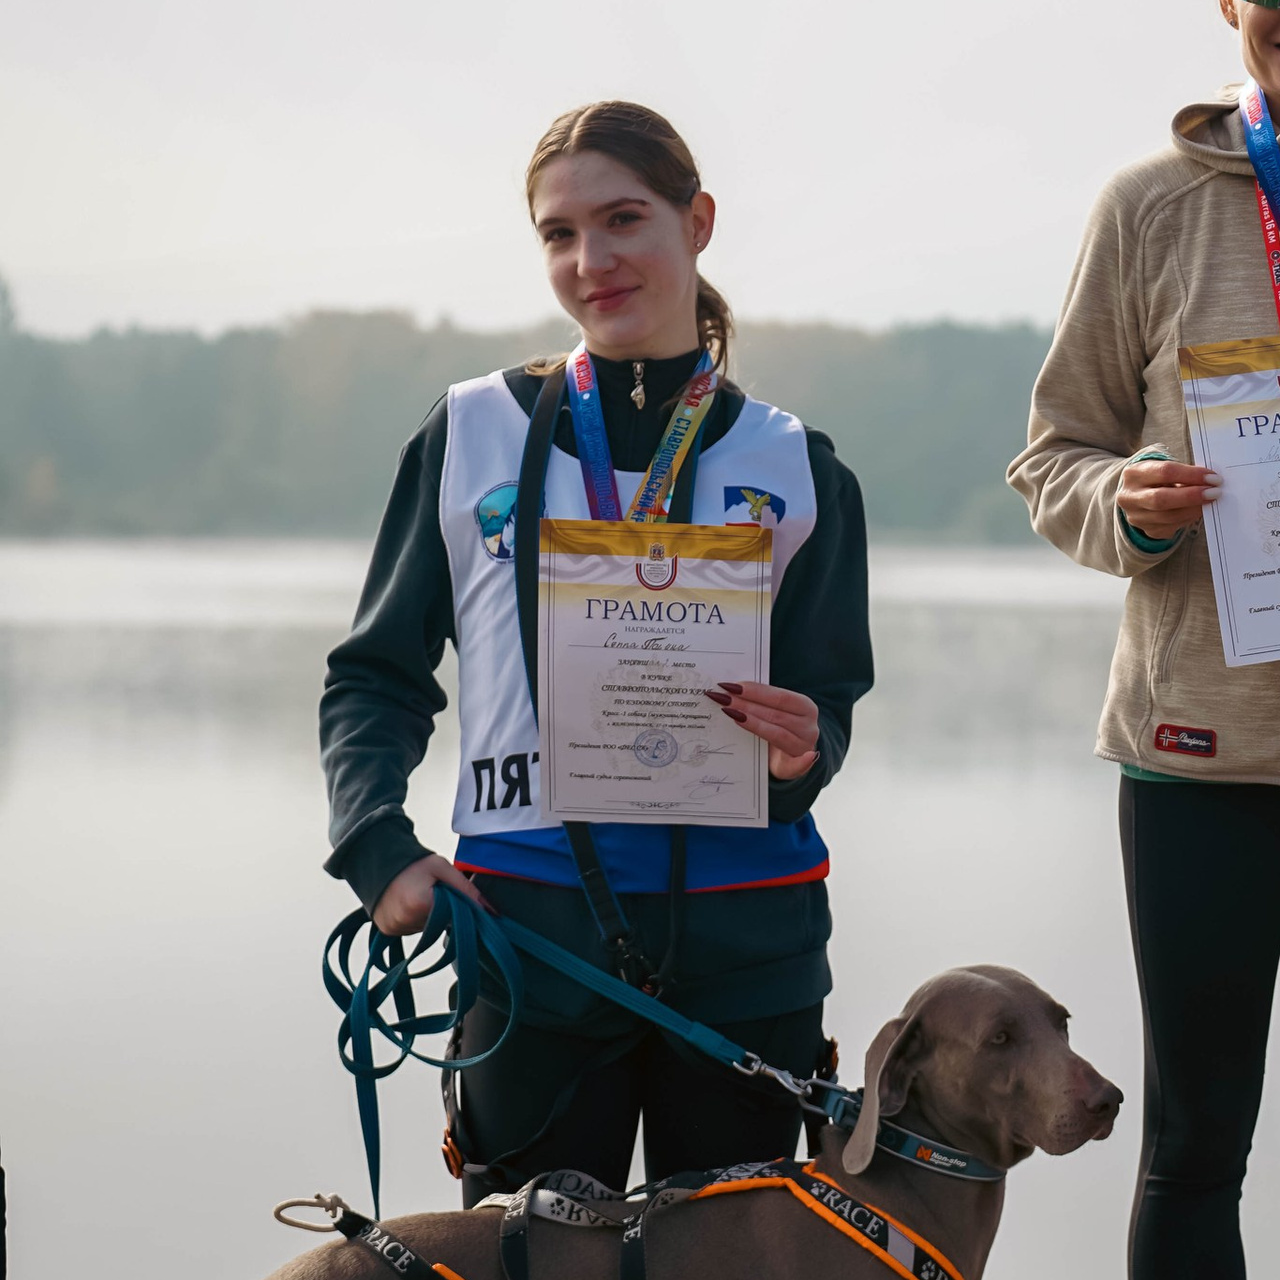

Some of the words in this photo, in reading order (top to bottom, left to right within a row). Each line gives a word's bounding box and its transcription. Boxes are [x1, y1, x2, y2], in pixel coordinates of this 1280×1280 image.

[638, 417, 691, 509] СТАВРОПОЛЬСКИЙ
[631, 509, 648, 522] КР
[585, 599, 725, 624] ГРАМОТА
[1249, 605, 1275, 614] Главный
[625, 626, 685, 634] НАГРАЖДАЕТСЯ
[601, 685, 687, 695] СТАВРОПОЛЬСКОГО
[471, 751, 539, 813] ПЯ
[822, 1185, 888, 1240] RACE
[364, 1224, 416, 1275] RACE
